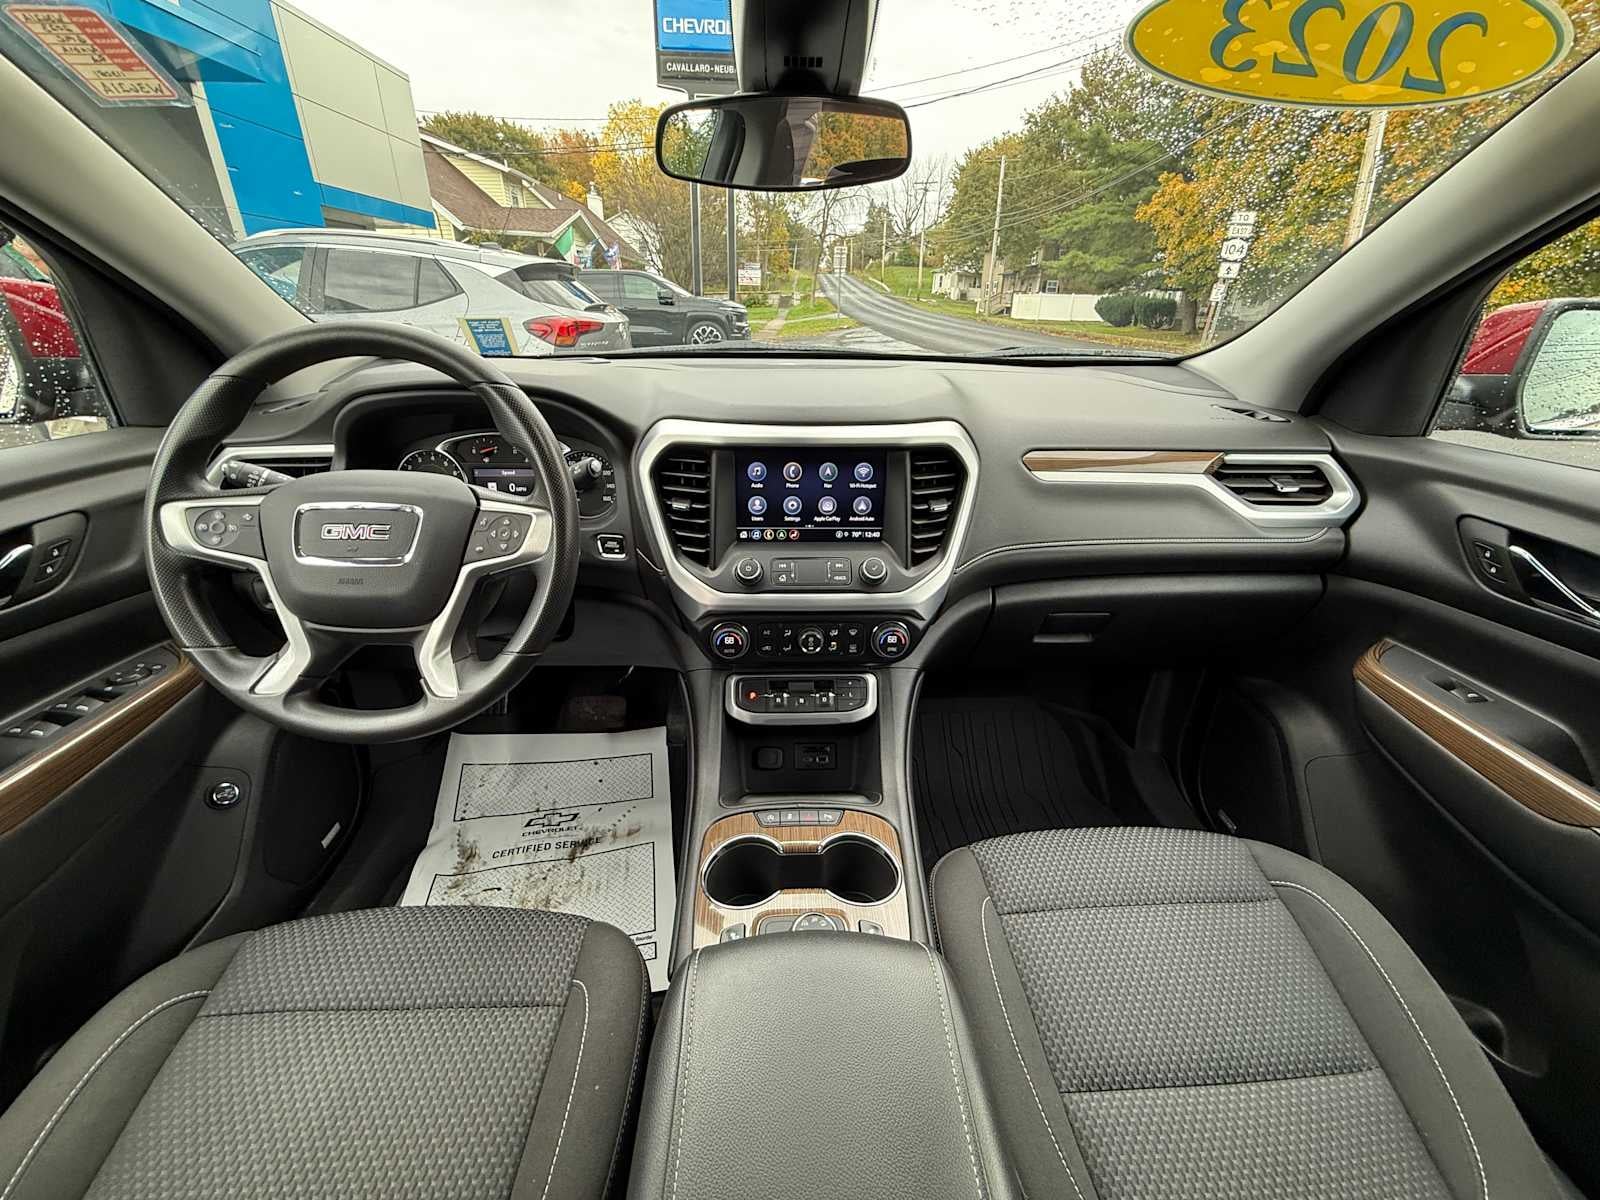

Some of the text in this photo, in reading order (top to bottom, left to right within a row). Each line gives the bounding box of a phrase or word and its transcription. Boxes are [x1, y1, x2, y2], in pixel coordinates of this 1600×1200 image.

[1231, 227, 1248, 235] EAST
[1224, 244, 1245, 255] 104
[508, 482, 516, 492] 0
[321, 523, 391, 540] GMC
[522, 825, 578, 837] CHEVROLET
[492, 842, 552, 859] CERTIFIED
